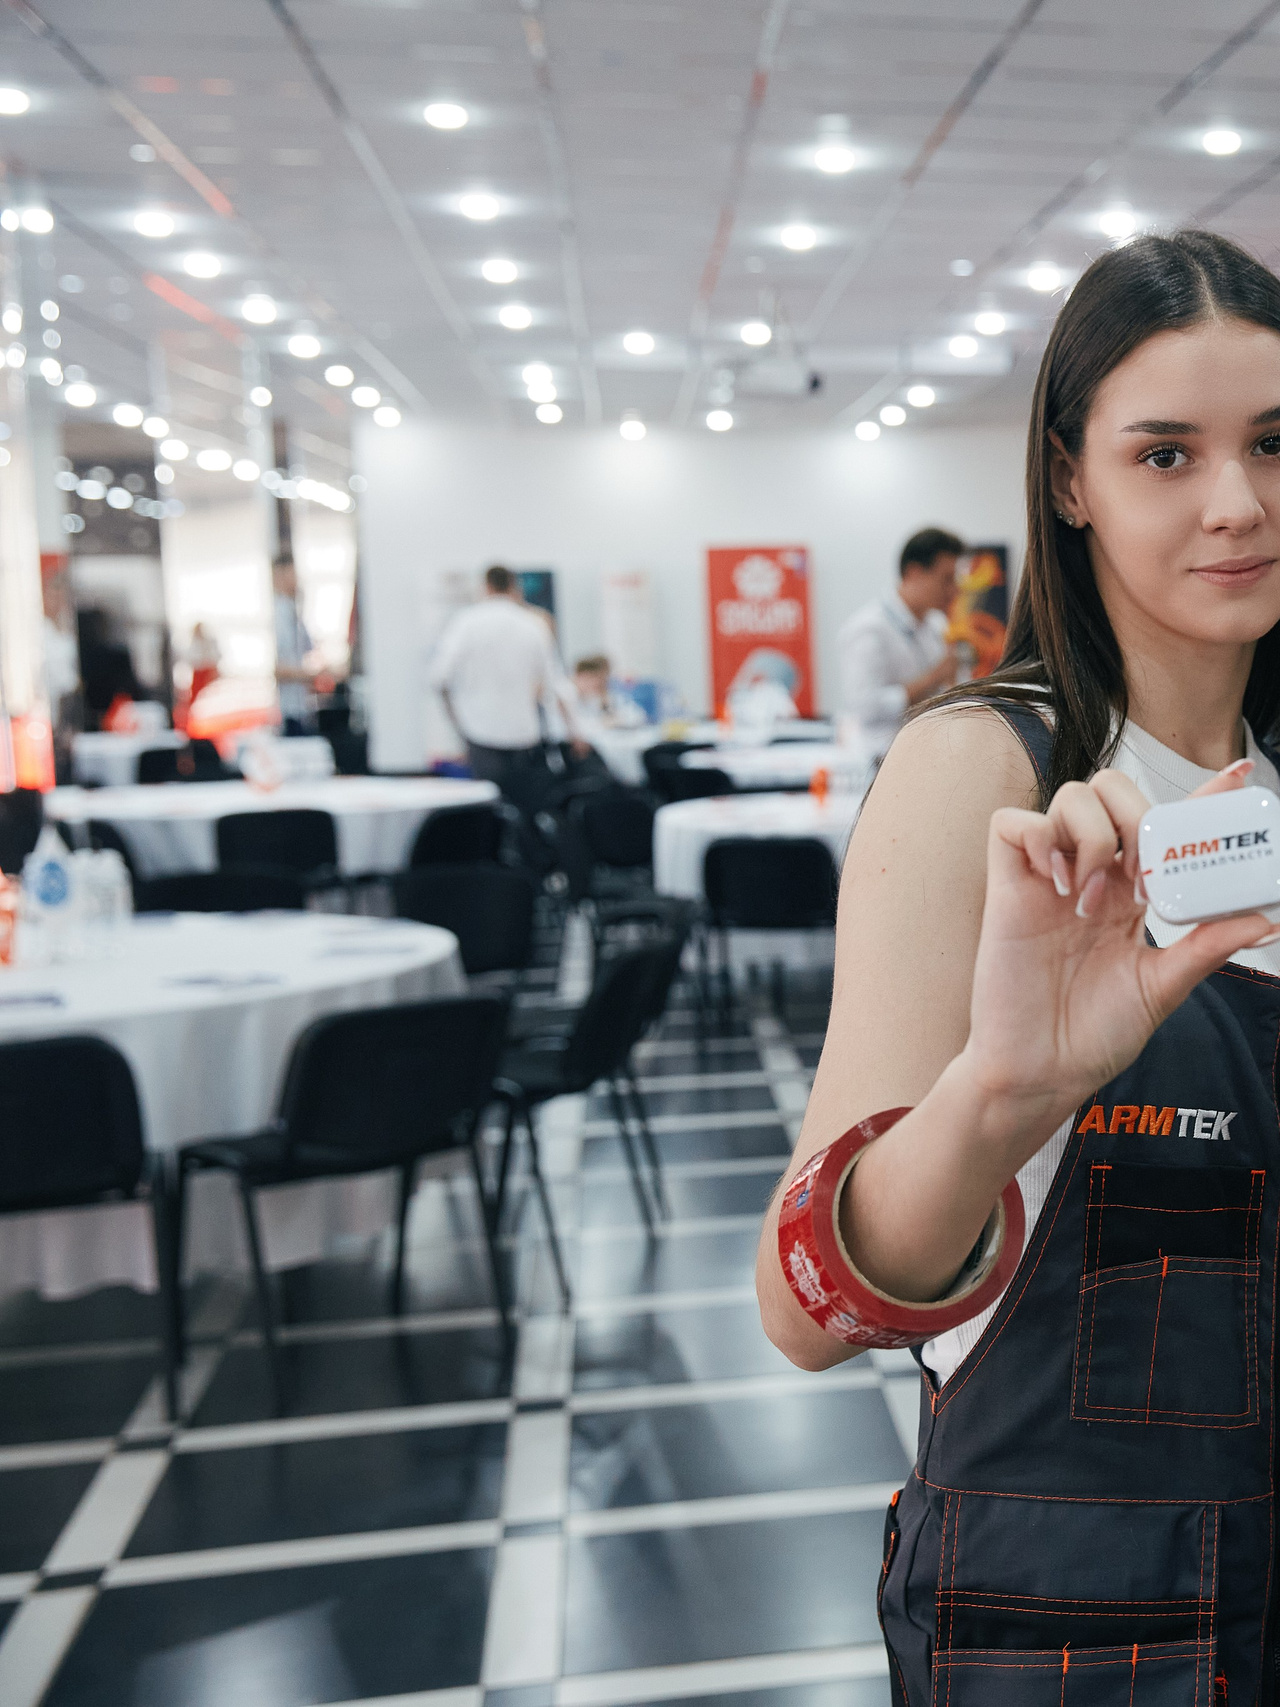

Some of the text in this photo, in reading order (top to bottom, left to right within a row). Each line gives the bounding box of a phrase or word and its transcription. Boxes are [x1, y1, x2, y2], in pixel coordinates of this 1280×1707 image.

[1164, 829, 1269, 862] ARMTEK
[1164, 848, 1273, 876] АВТОЗАПЧАСТИ
[1077, 1105, 1238, 1140] ARMTEK
